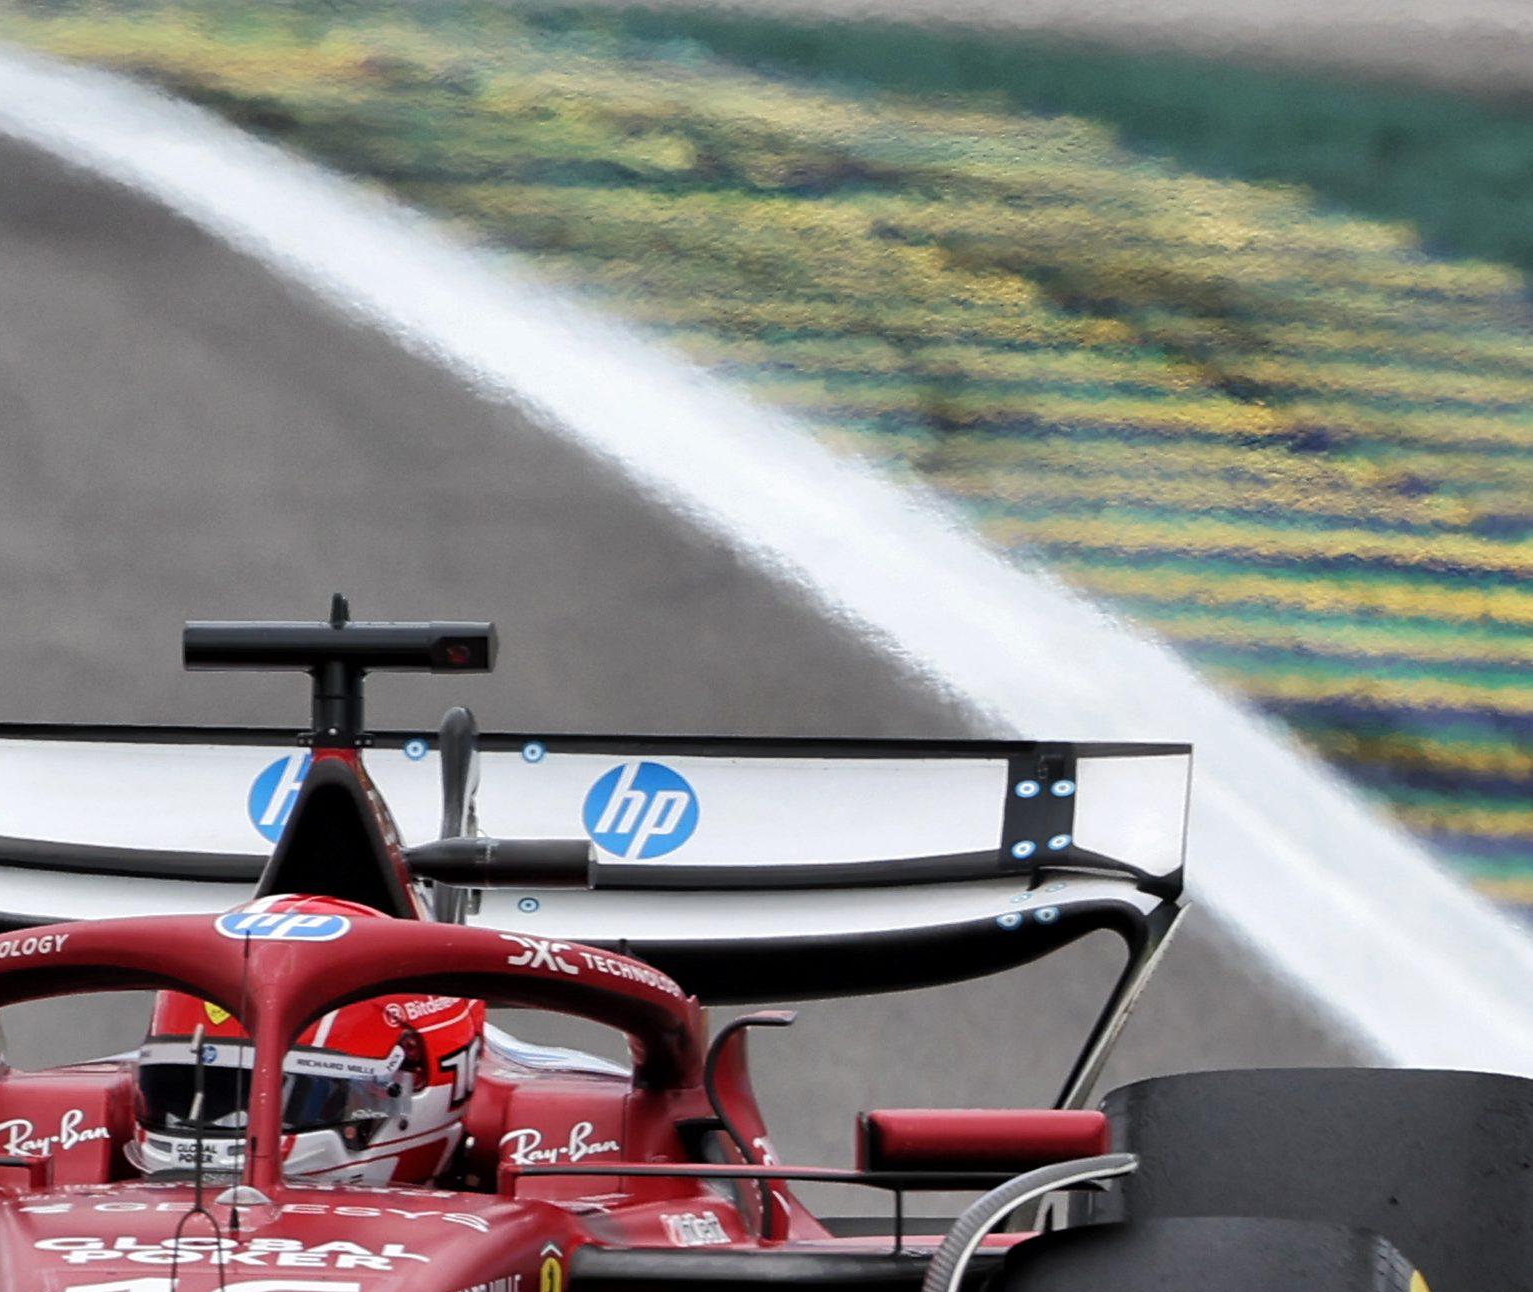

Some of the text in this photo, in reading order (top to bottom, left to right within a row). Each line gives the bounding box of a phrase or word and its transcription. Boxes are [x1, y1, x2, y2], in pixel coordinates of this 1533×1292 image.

[589, 761, 692, 859] hp
[499, 933, 579, 975] DXC
[296, 1058, 375, 1076] RICHARD MILLE
[176, 1143, 217, 1154] GLOAL
[499, 1122, 620, 1165] Ray-Ban
[178, 1153, 213, 1163] POER
[94, 1201, 491, 1234] GEESYS
[33, 1235, 433, 1263] GLOBAL
[62, 1249, 394, 1272] POKER
